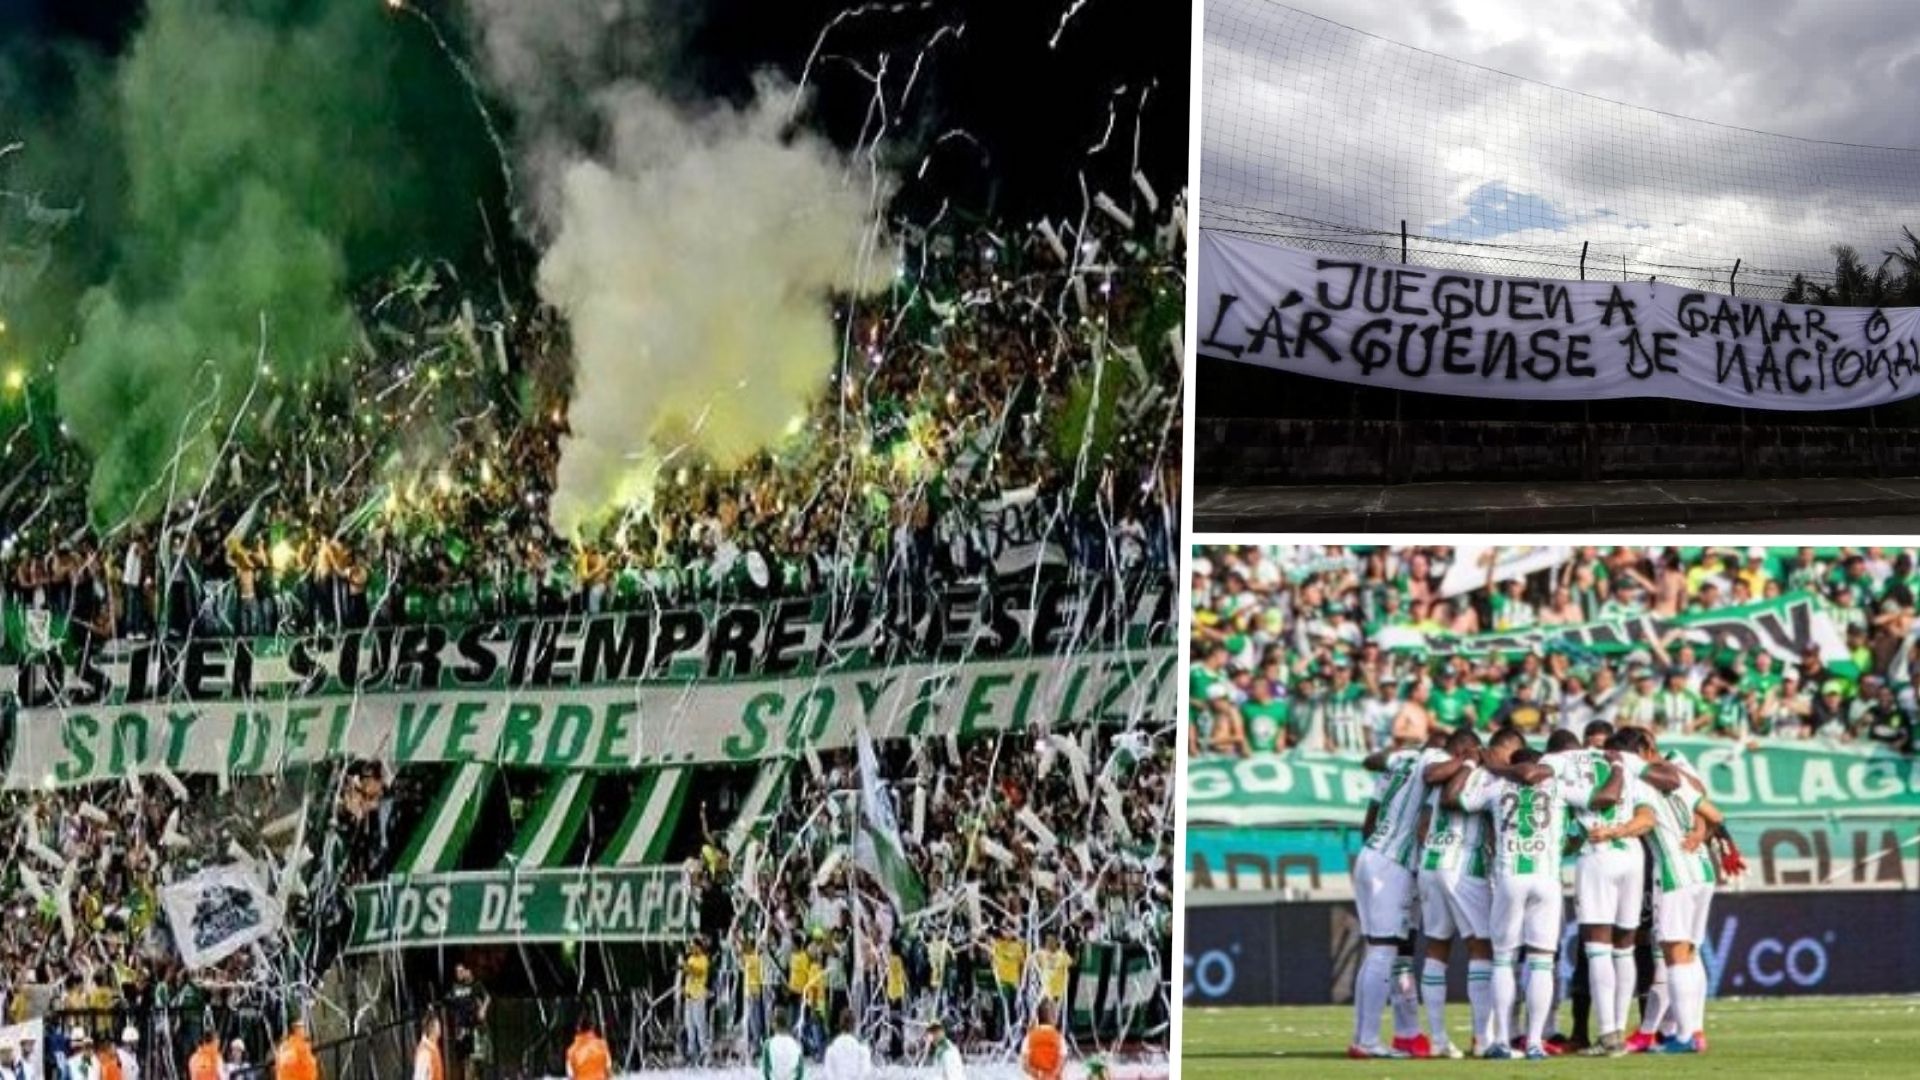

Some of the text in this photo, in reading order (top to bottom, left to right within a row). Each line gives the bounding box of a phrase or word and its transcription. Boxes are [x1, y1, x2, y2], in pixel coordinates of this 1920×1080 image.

[1316, 258, 1573, 328] JUEGUEN
[1596, 286, 1637, 326] A
[1677, 293, 1839, 346] GANAR
[54, 710, 202, 782] SOY
[1499, 792, 1551, 832] 23
[365, 883, 450, 940] LOS
[477, 882, 535, 931] DE
